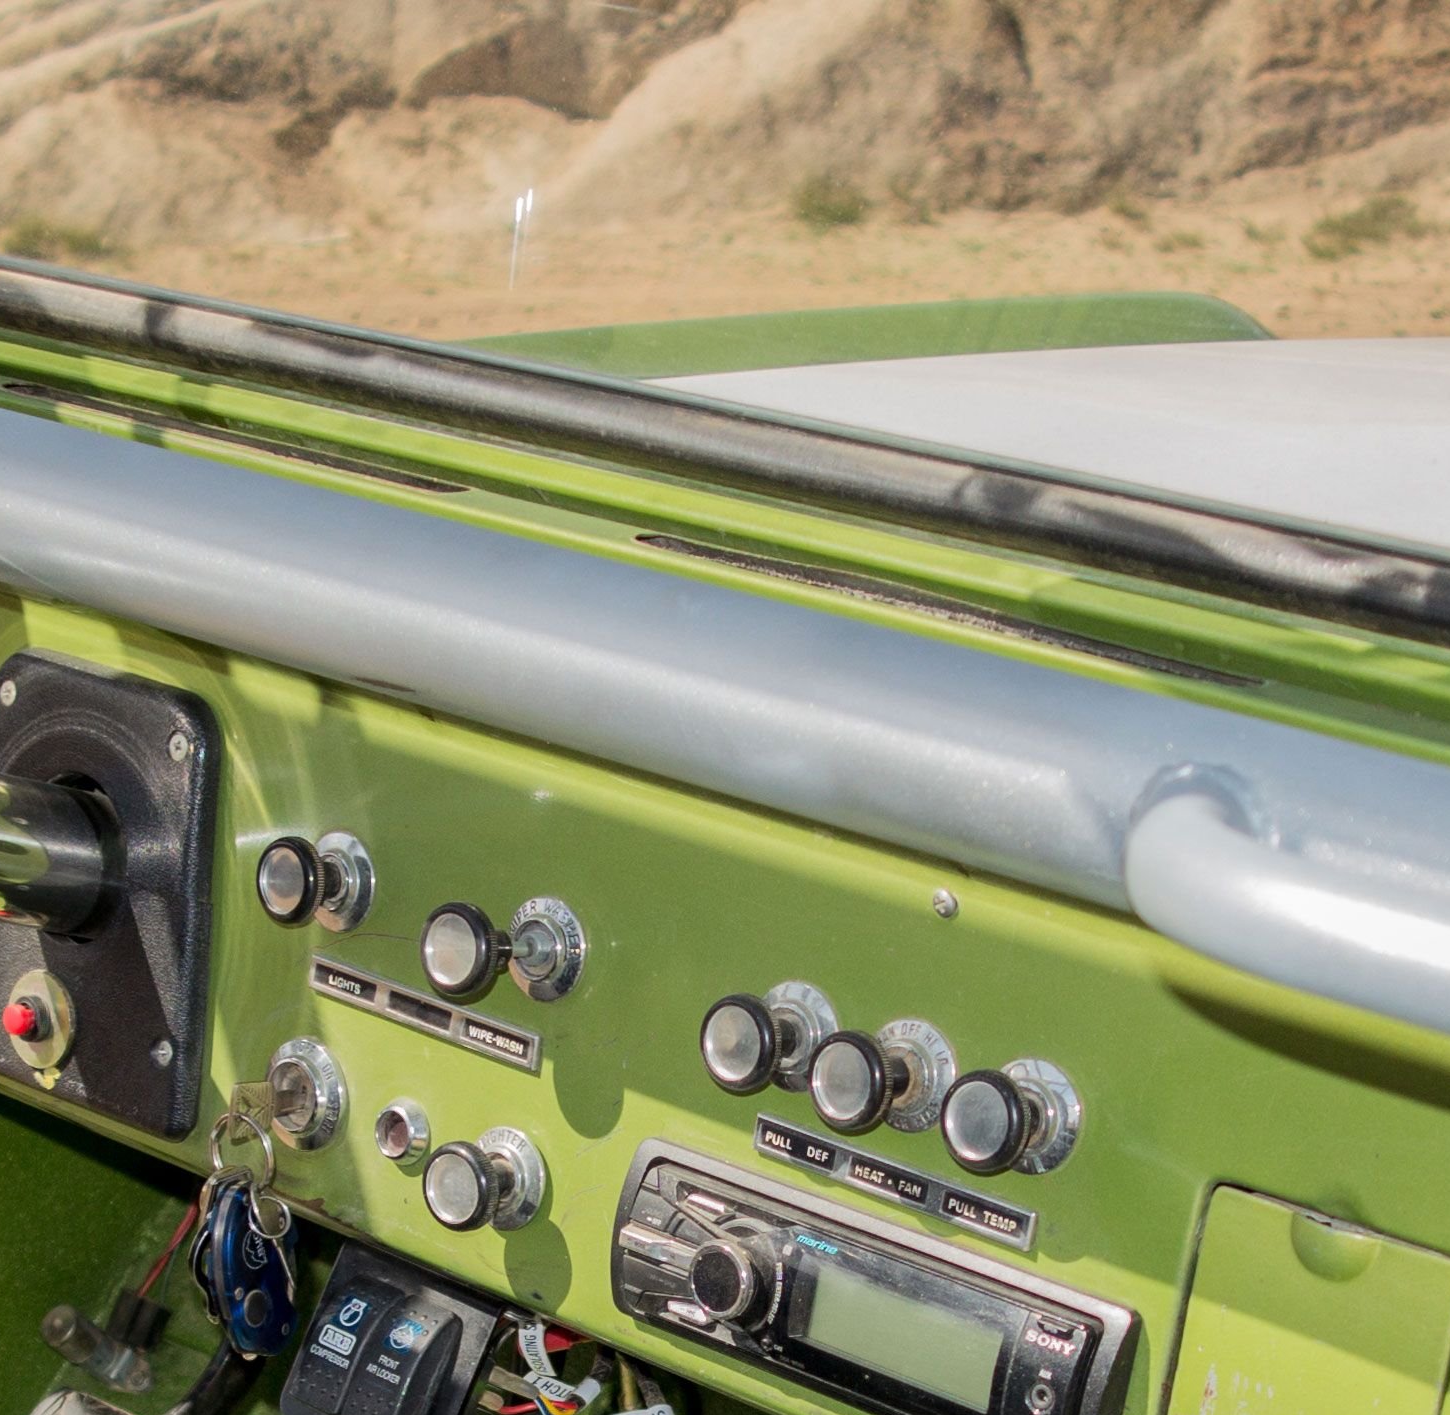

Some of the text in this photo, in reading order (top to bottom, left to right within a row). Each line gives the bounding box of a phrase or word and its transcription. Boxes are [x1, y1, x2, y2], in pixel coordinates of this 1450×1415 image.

[328, 973, 361, 995] LIGHTS
[468, 1025, 524, 1055] WIPE-WASH
[901, 1022, 921, 1038] OFF
[765, 1131, 829, 1162] PULL DEF
[854, 1164, 922, 1198] HEAT FAN
[948, 1198, 1017, 1232] PULL TEMP
[796, 1234, 838, 1255] marine
[323, 1329, 352, 1351] ARB
[1025, 1329, 1077, 1358] SONY
[310, 1344, 350, 1370] COMPRESSOR
[378, 1354, 400, 1370] FRONT
[524, 1335, 548, 1373] ISOLATING
[366, 1363, 401, 1385] AIR LOCKER
